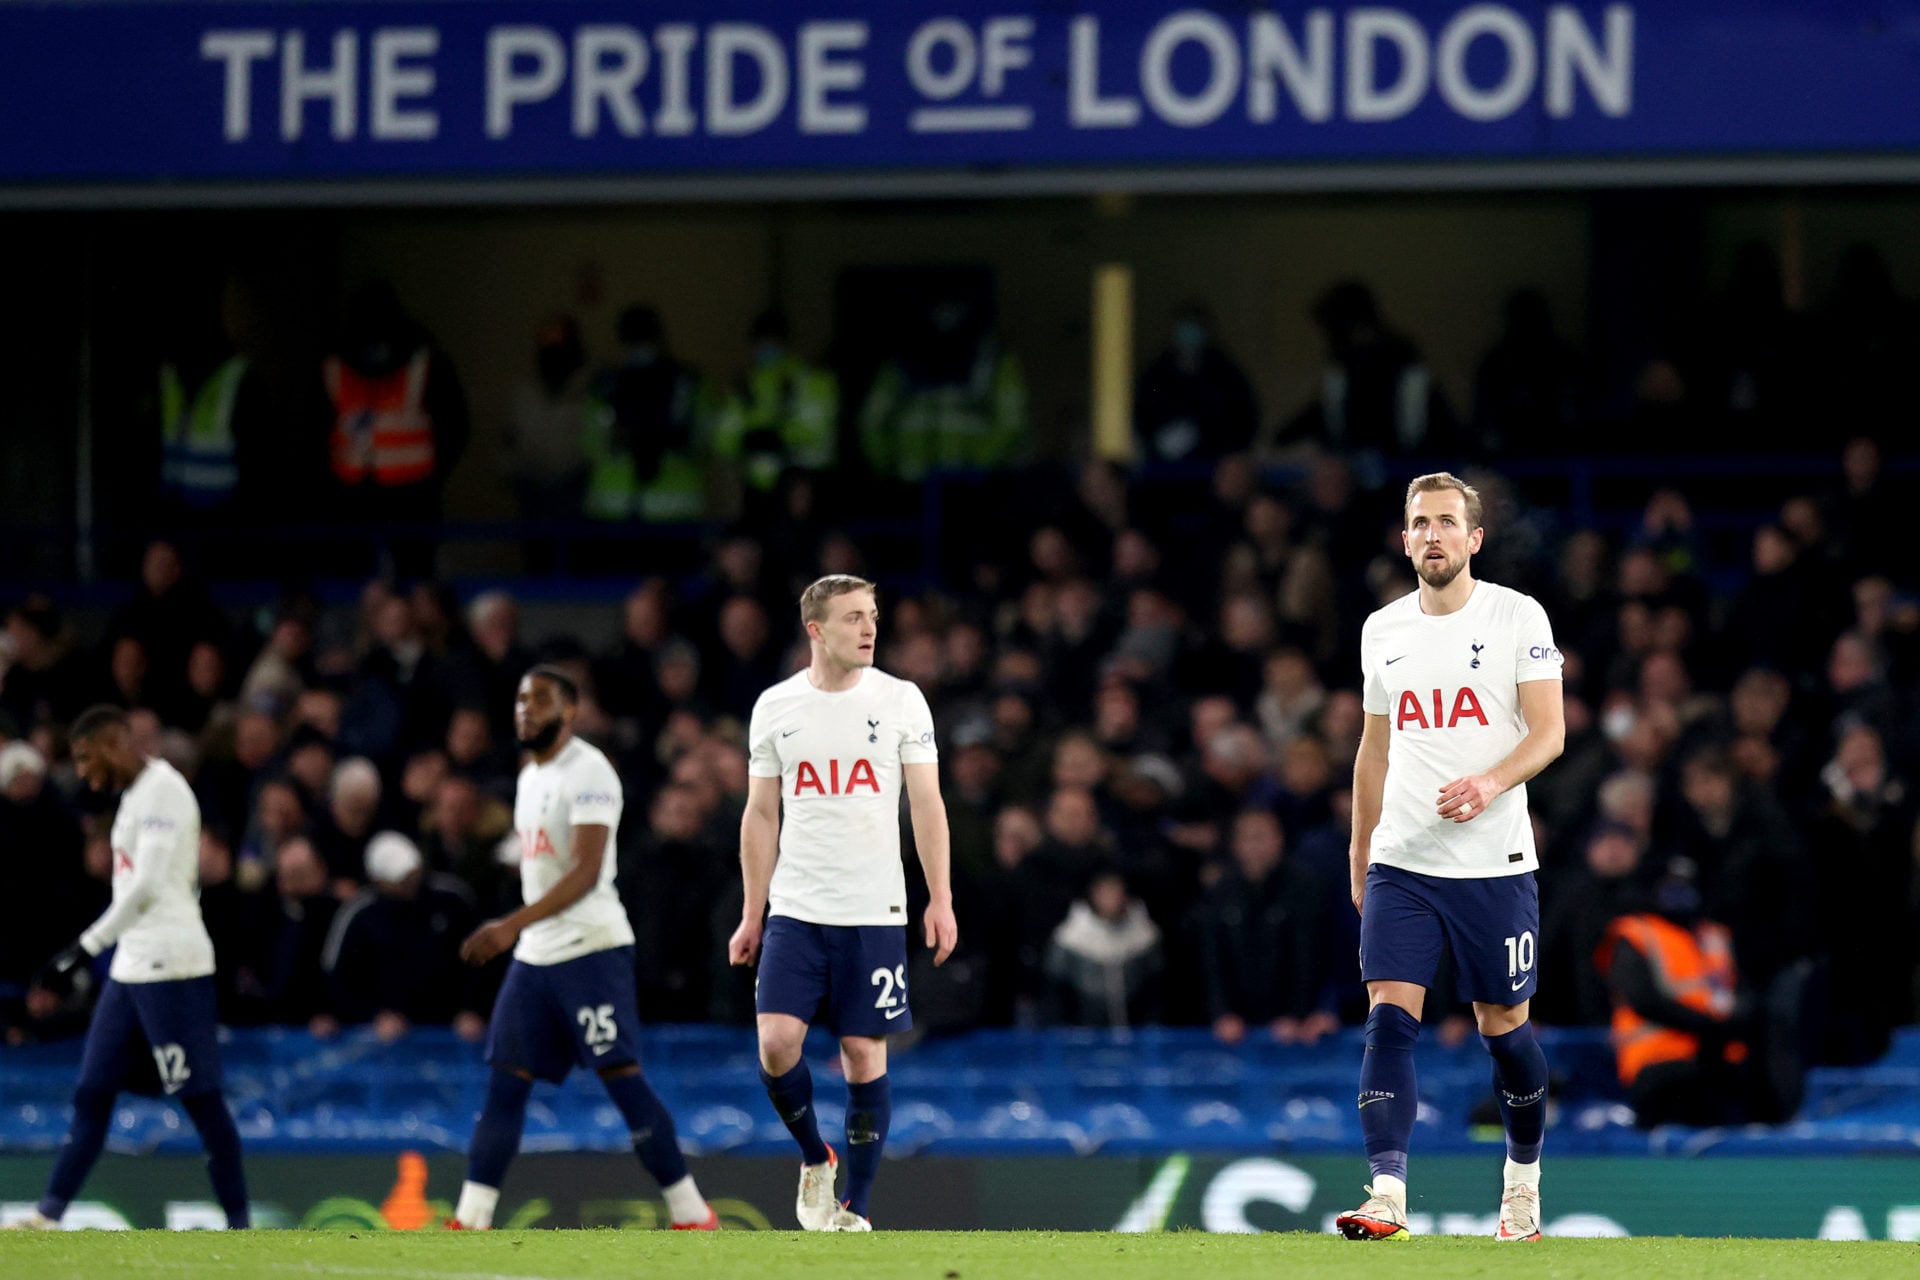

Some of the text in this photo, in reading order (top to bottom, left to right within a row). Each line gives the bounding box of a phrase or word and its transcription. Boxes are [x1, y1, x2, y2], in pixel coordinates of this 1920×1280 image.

[201, 3, 1635, 142] THE PRIDE OF LONDON
[1397, 686, 1489, 731] AIA
[794, 758, 881, 796] AIA
[1504, 930, 1534, 977] 10
[577, 1004, 618, 1045] 25
[152, 1043, 191, 1083] 12
